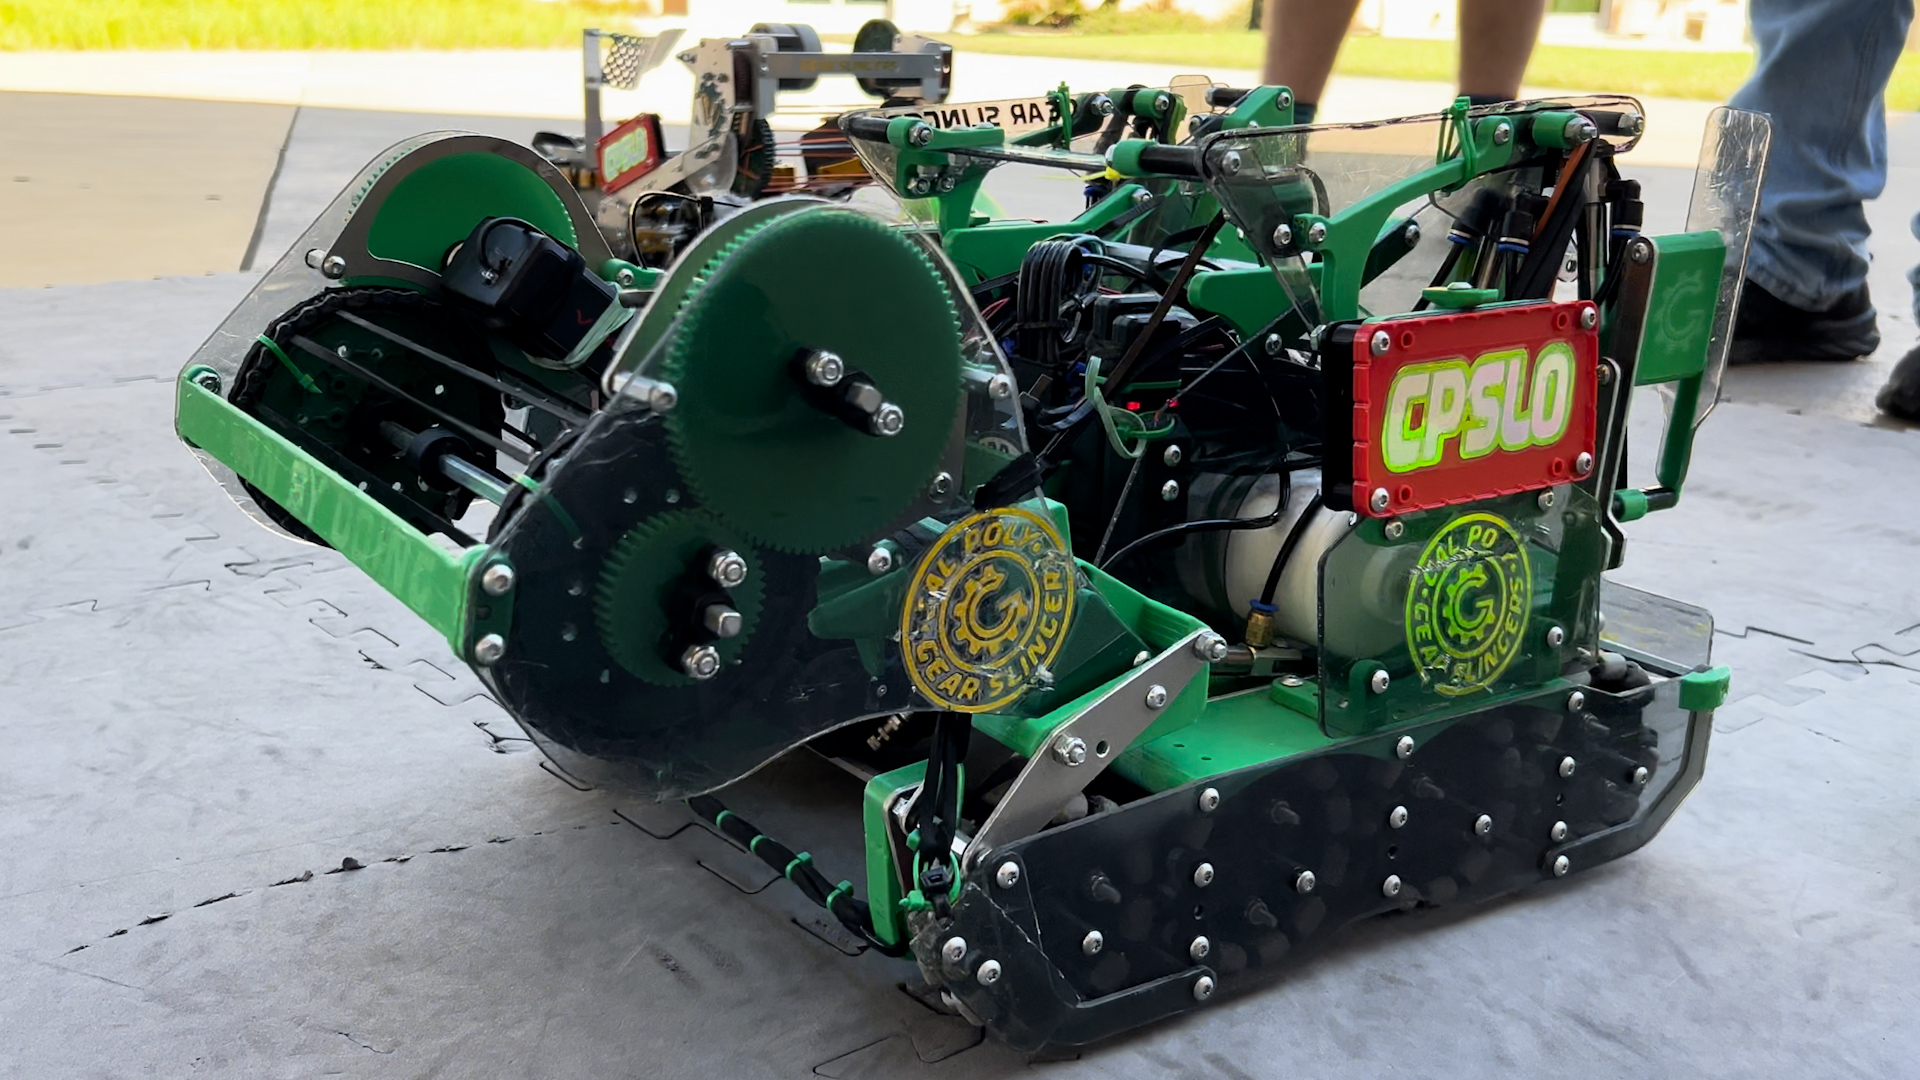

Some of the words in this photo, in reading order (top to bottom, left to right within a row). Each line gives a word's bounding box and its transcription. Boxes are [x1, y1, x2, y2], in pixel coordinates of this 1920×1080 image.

[1382, 342, 1575, 473] CPSLO
[916, 557, 958, 620] AL
[964, 522, 1042, 553] POLY
[916, 639, 980, 701] GEAR
[989, 560, 1064, 697] SLINGER
[1451, 576, 1524, 683] SLINGERS
